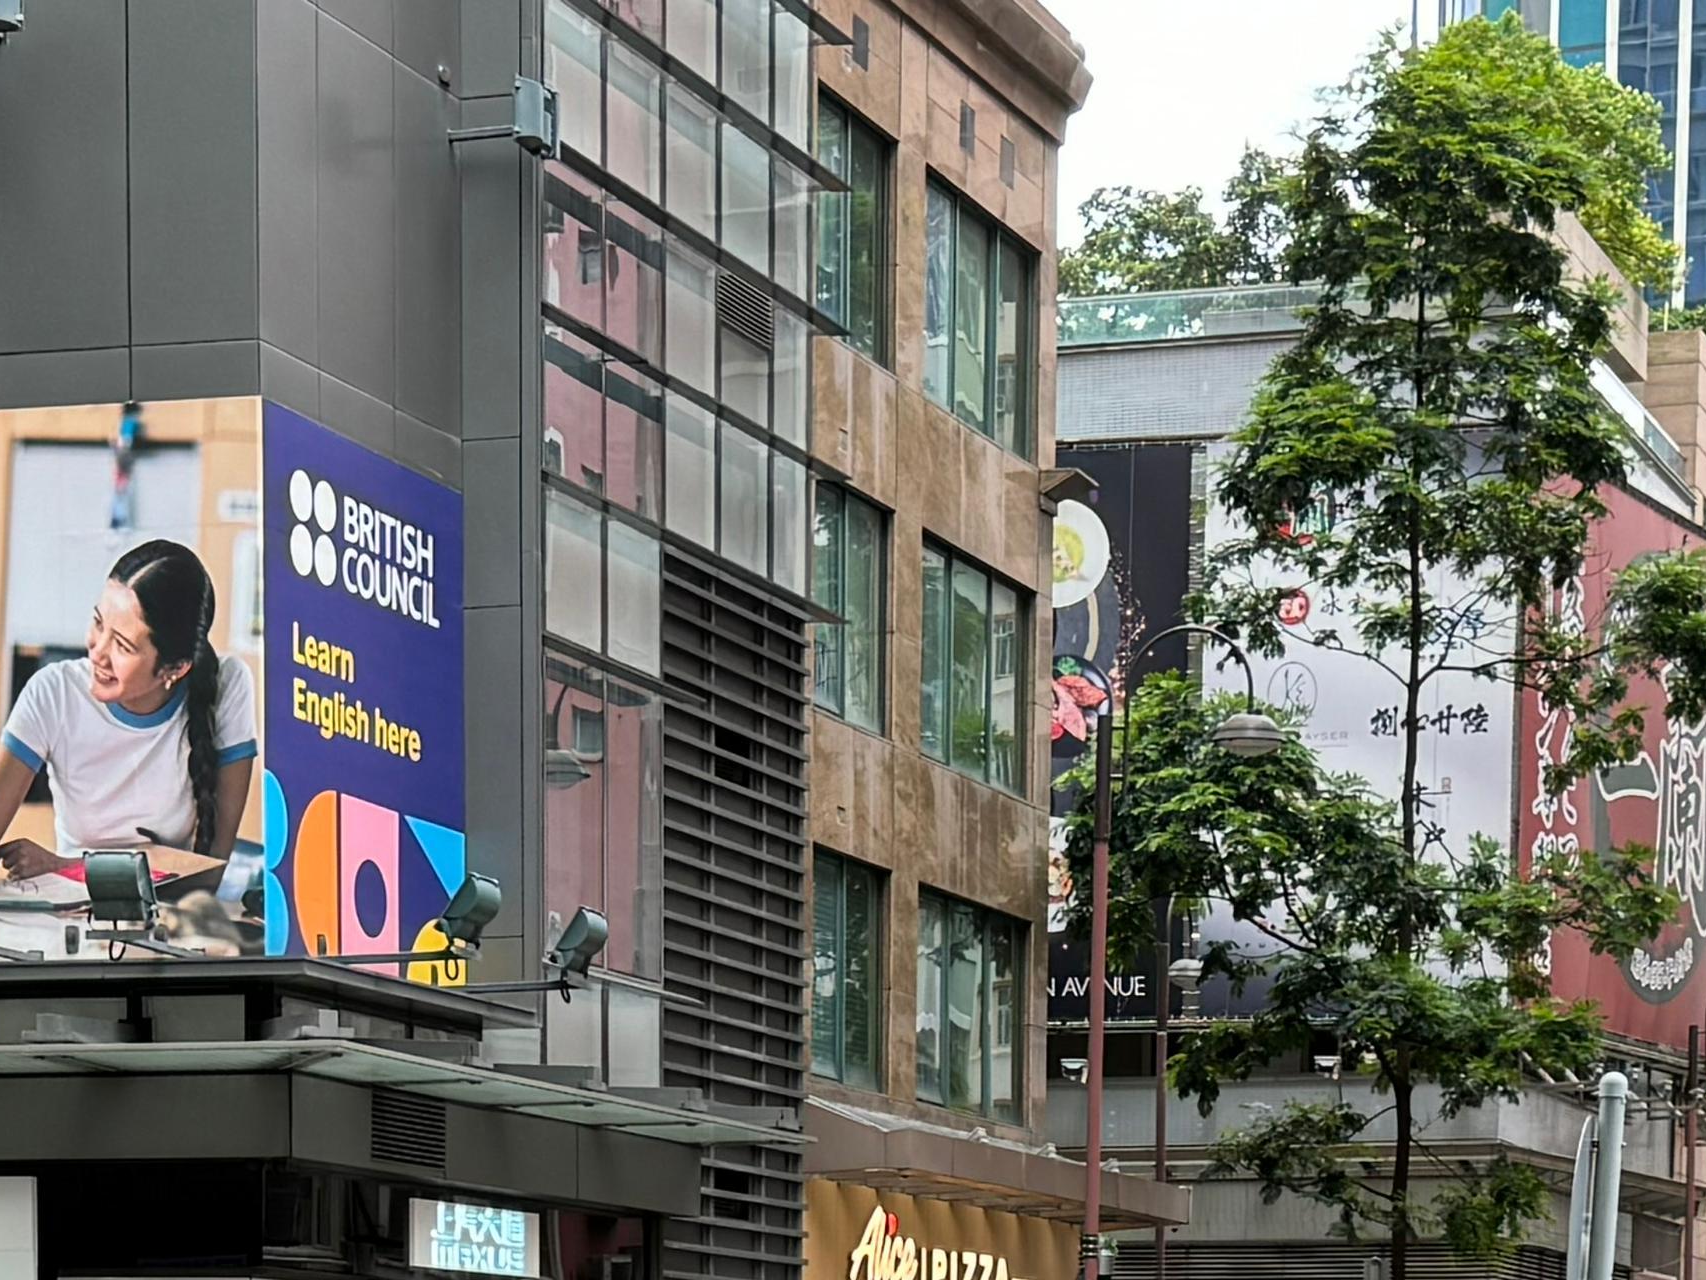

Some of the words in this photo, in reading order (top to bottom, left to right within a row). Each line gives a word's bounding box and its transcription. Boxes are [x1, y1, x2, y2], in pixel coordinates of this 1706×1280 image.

[343, 494, 435, 578] BRITISH
[342, 546, 441, 630] COUNCIL
[292, 620, 355, 684] Learn
[292, 678, 371, 743] English
[373, 707, 422, 762] here
[1061, 976, 1146, 997] AVNUE
